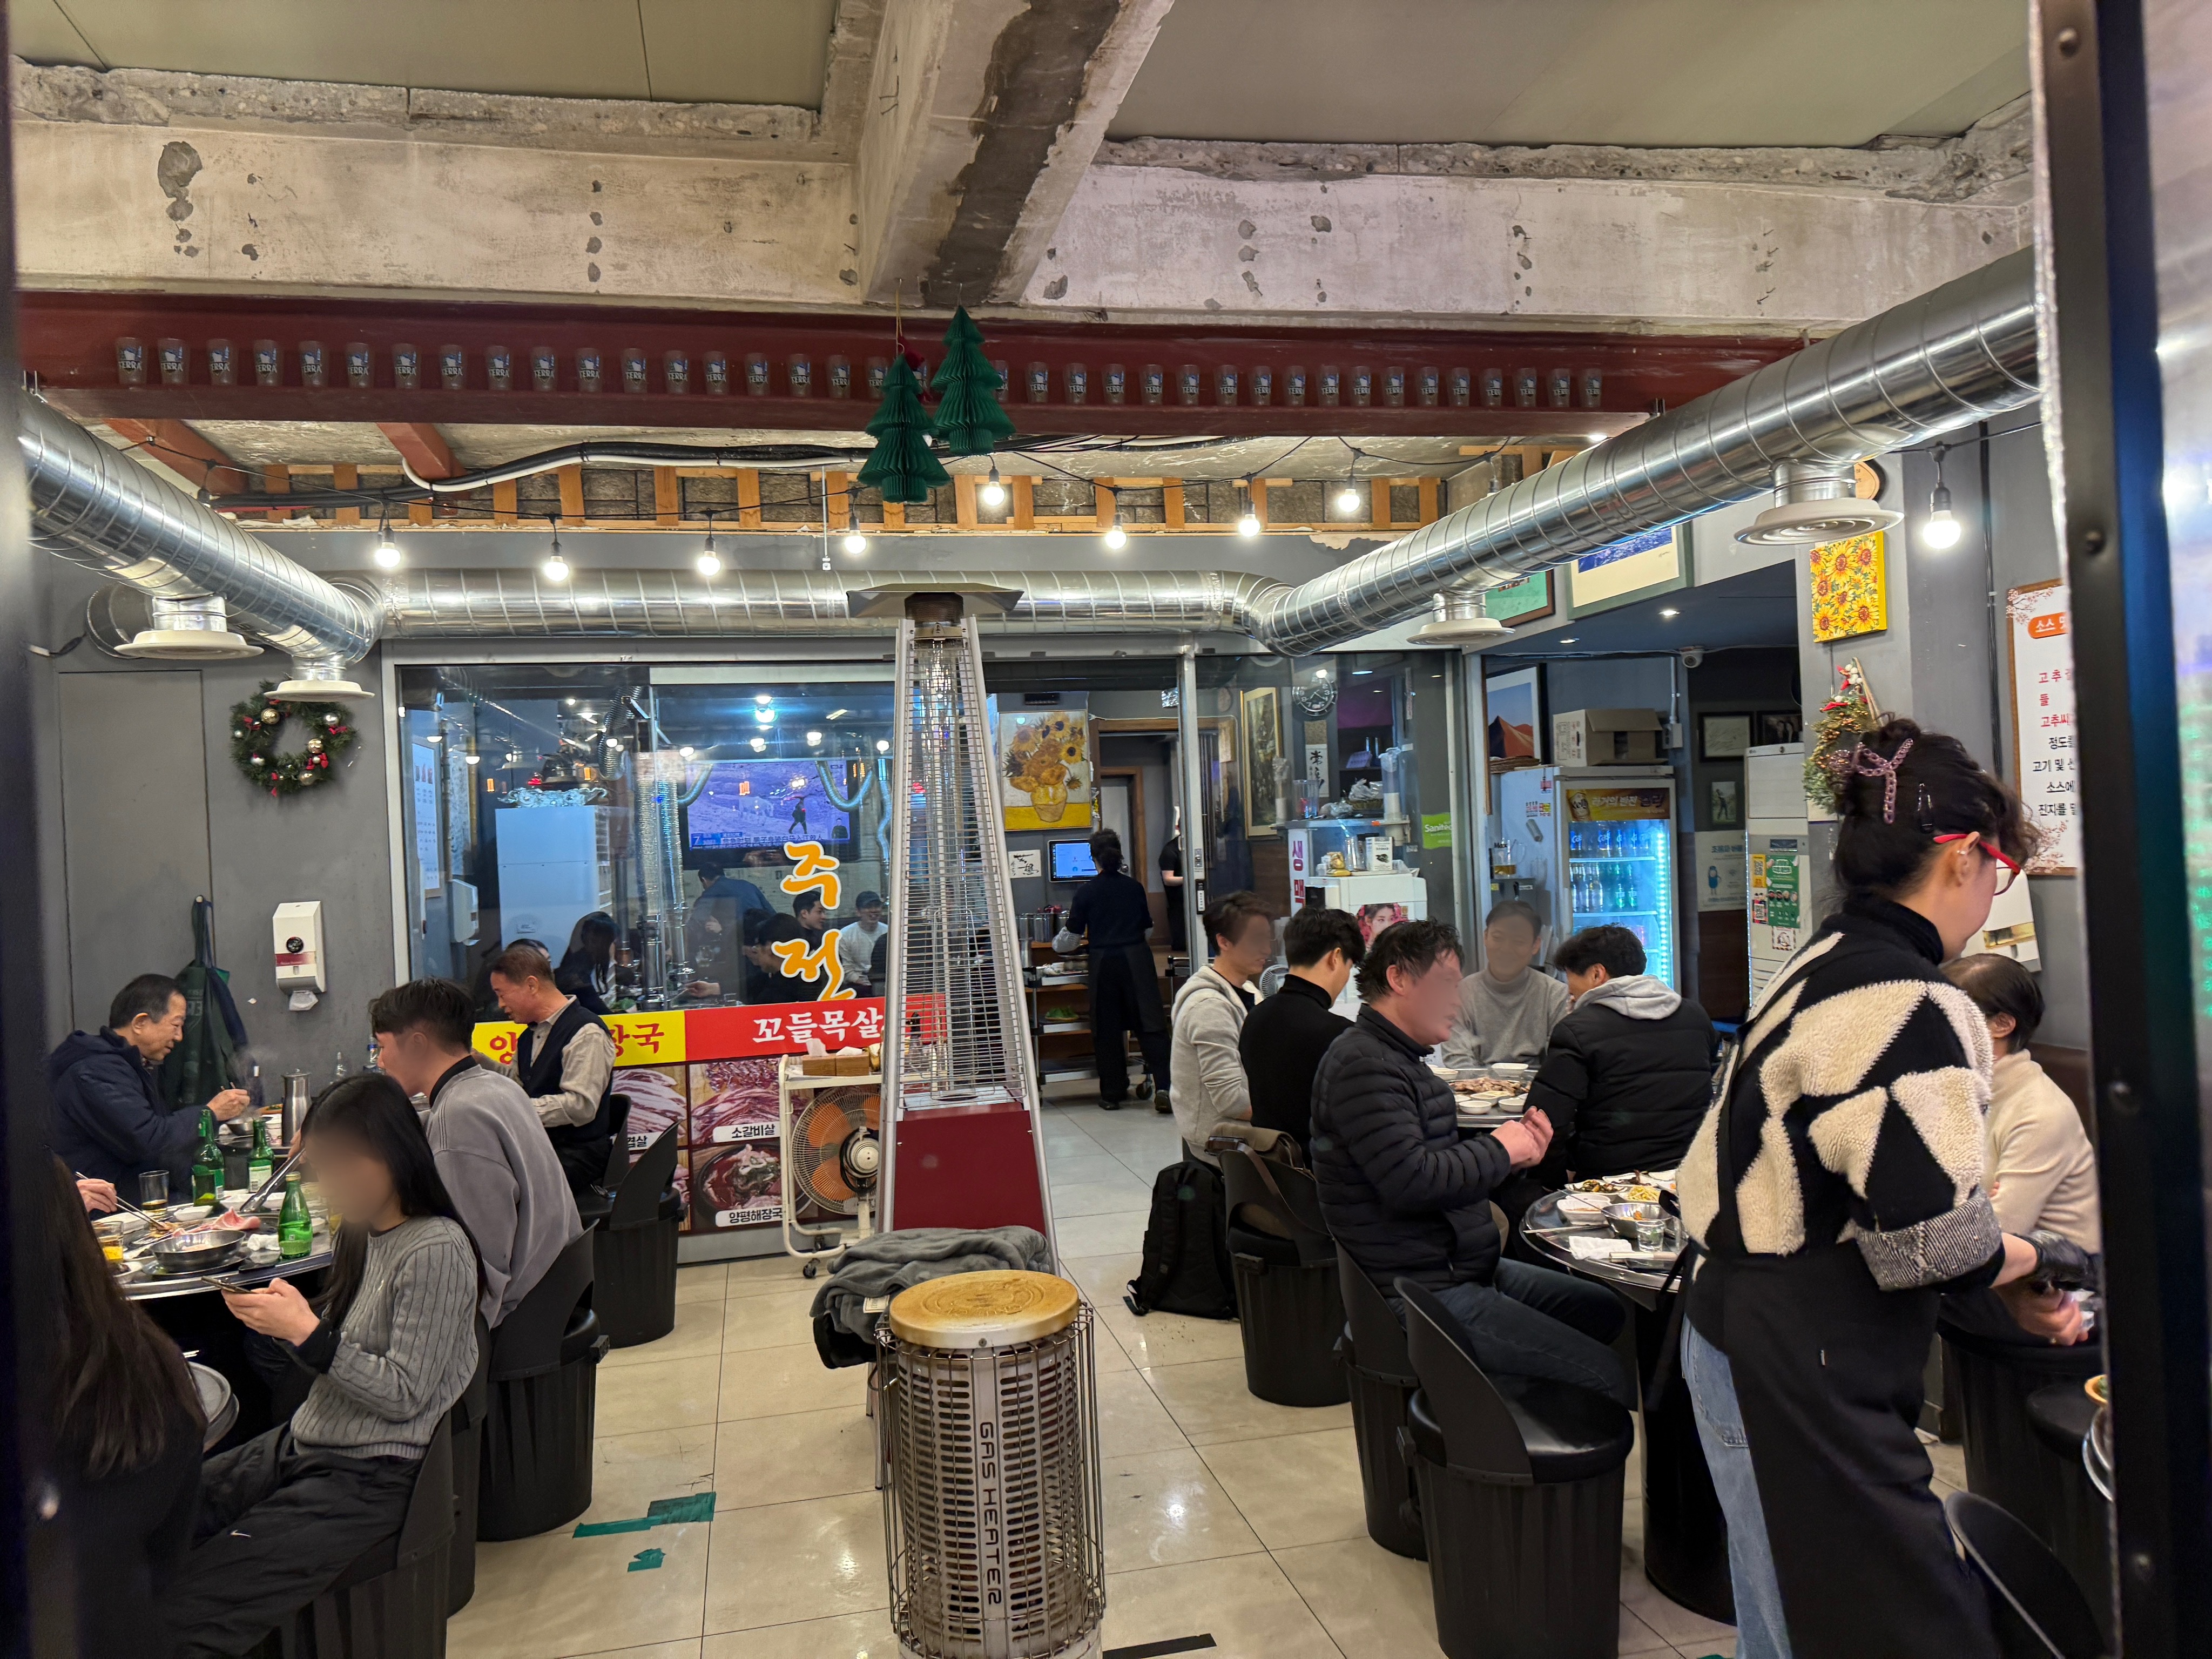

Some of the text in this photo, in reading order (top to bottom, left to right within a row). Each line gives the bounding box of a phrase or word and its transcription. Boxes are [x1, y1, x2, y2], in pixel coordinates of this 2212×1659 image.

[119, 361, 141, 370] TERRA
[161, 361, 183, 372] TERRA
[255, 363, 277, 373] TERRA
[301, 364, 322, 373] TERRA
[348, 367, 368, 376] TERRA
[395, 366, 416, 375] TERRA
[442, 367, 463, 376] TERRA
[489, 368, 509, 377] TERRA
[534, 369, 554, 378] TERRA
[579, 369, 599, 379] TERRA
[626, 371, 646, 381] TERRA
[667, 372, 687, 381] TERRA
[706, 373, 726, 382] TERRA
[749, 375, 767, 383] TERRA
[791, 375, 810, 384] TERRA
[2035, 618, 2055, 632] 소스
[2032, 759, 2052, 772] 고기
[2054, 758, 2065, 771] 및
[752, 1007, 884, 1044] 꼬들목살
[732, 1123, 775, 1138] 소갈비살
[626, 1135, 648, 1148] 겹살
[729, 1208, 783, 1223] 양평해장국
[980, 1421, 1002, 1606] GAS HEATER
